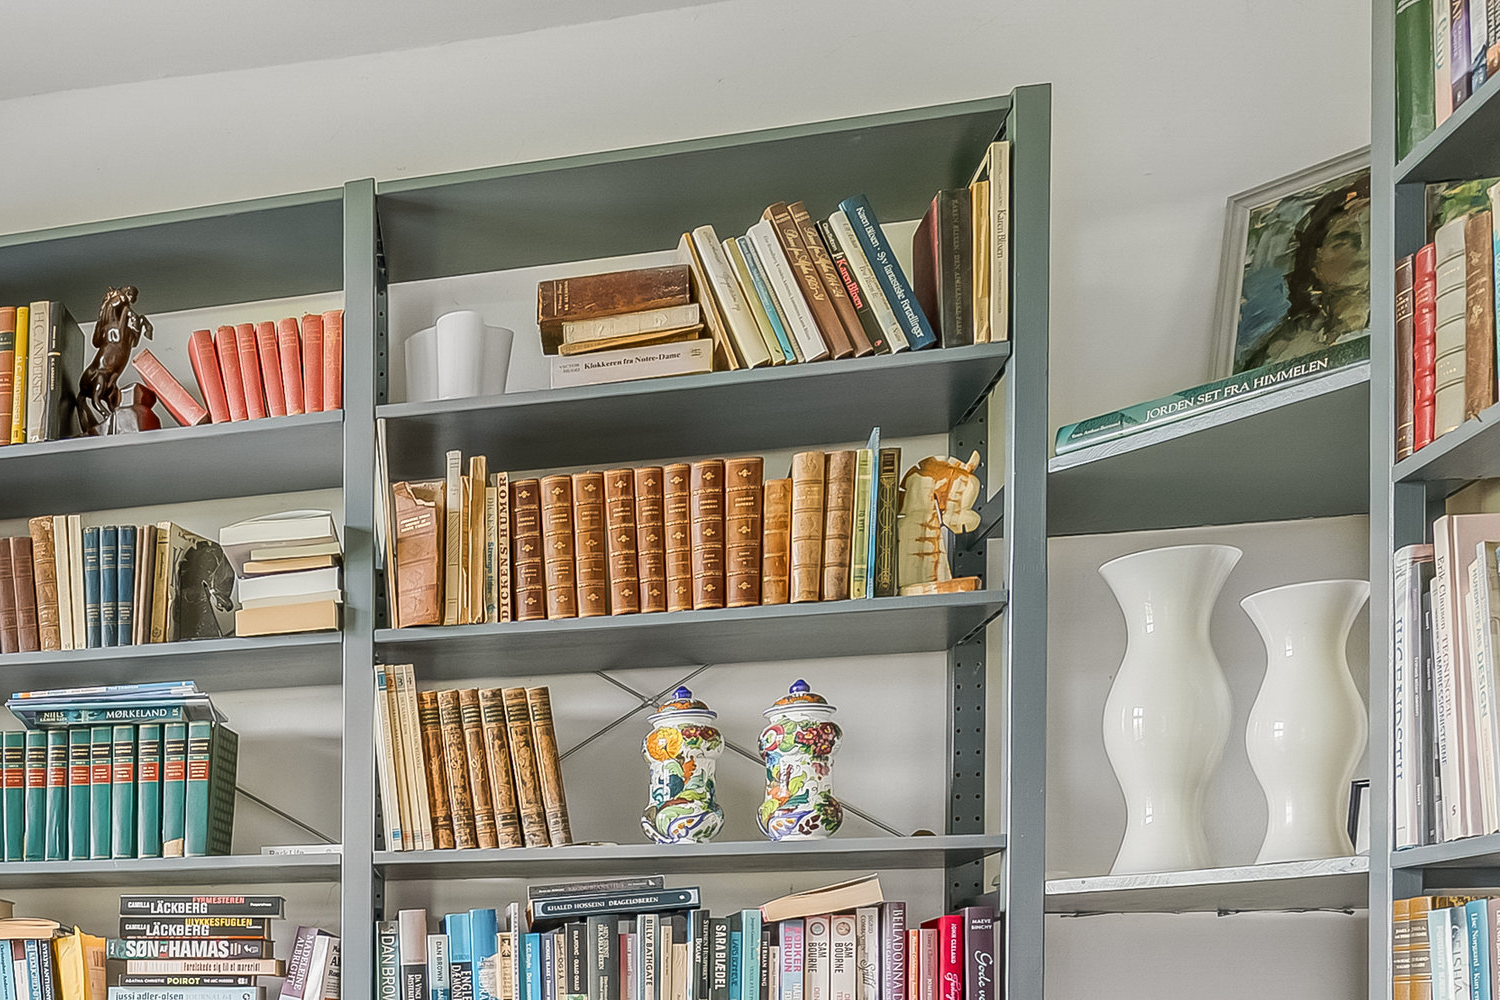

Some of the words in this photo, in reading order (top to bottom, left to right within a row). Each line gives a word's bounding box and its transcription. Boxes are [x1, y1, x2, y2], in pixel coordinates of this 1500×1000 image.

[997, 210, 1006, 234] Karen
[836, 258, 854, 282] Karen
[845, 282, 864, 309] Blixen
[584, 359, 622, 370] Klokkeren
[635, 352, 681, 363] Notre-Dame
[1145, 398, 1194, 422] JORDEN
[1196, 390, 1221, 406] SET
[1223, 383, 1250, 398] FRA
[1253, 358, 1329, 390] HIMMELEN
[499, 476, 507, 538] HUMOR
[500, 542, 508, 622] DICKENS'
[1437, 555, 1446, 580] Erik
[1438, 583, 1449, 630] Clausen
[1441, 633, 1453, 718] TEGNINGER
[106, 709, 167, 718] MØRKELAND
[185, 918, 252, 926] ULYKKESFUGLEN
[715, 925, 726, 950] SARA
[286, 937, 303, 985] ALBRIGHT
[293, 935, 314, 990] MADELEINE
[382, 936, 394, 963] DAN
[808, 942, 817, 973] BOURNE
[818, 942, 827, 958] SAM
[834, 942, 844, 973] BOURNE
[844, 942, 853, 958] SAM
[892, 909, 903, 988] BELLADONNA
[714, 952, 726, 990] BLÆDEL
[973, 951, 993, 988] Gode
[461, 971, 472, 1000] ENGLE
